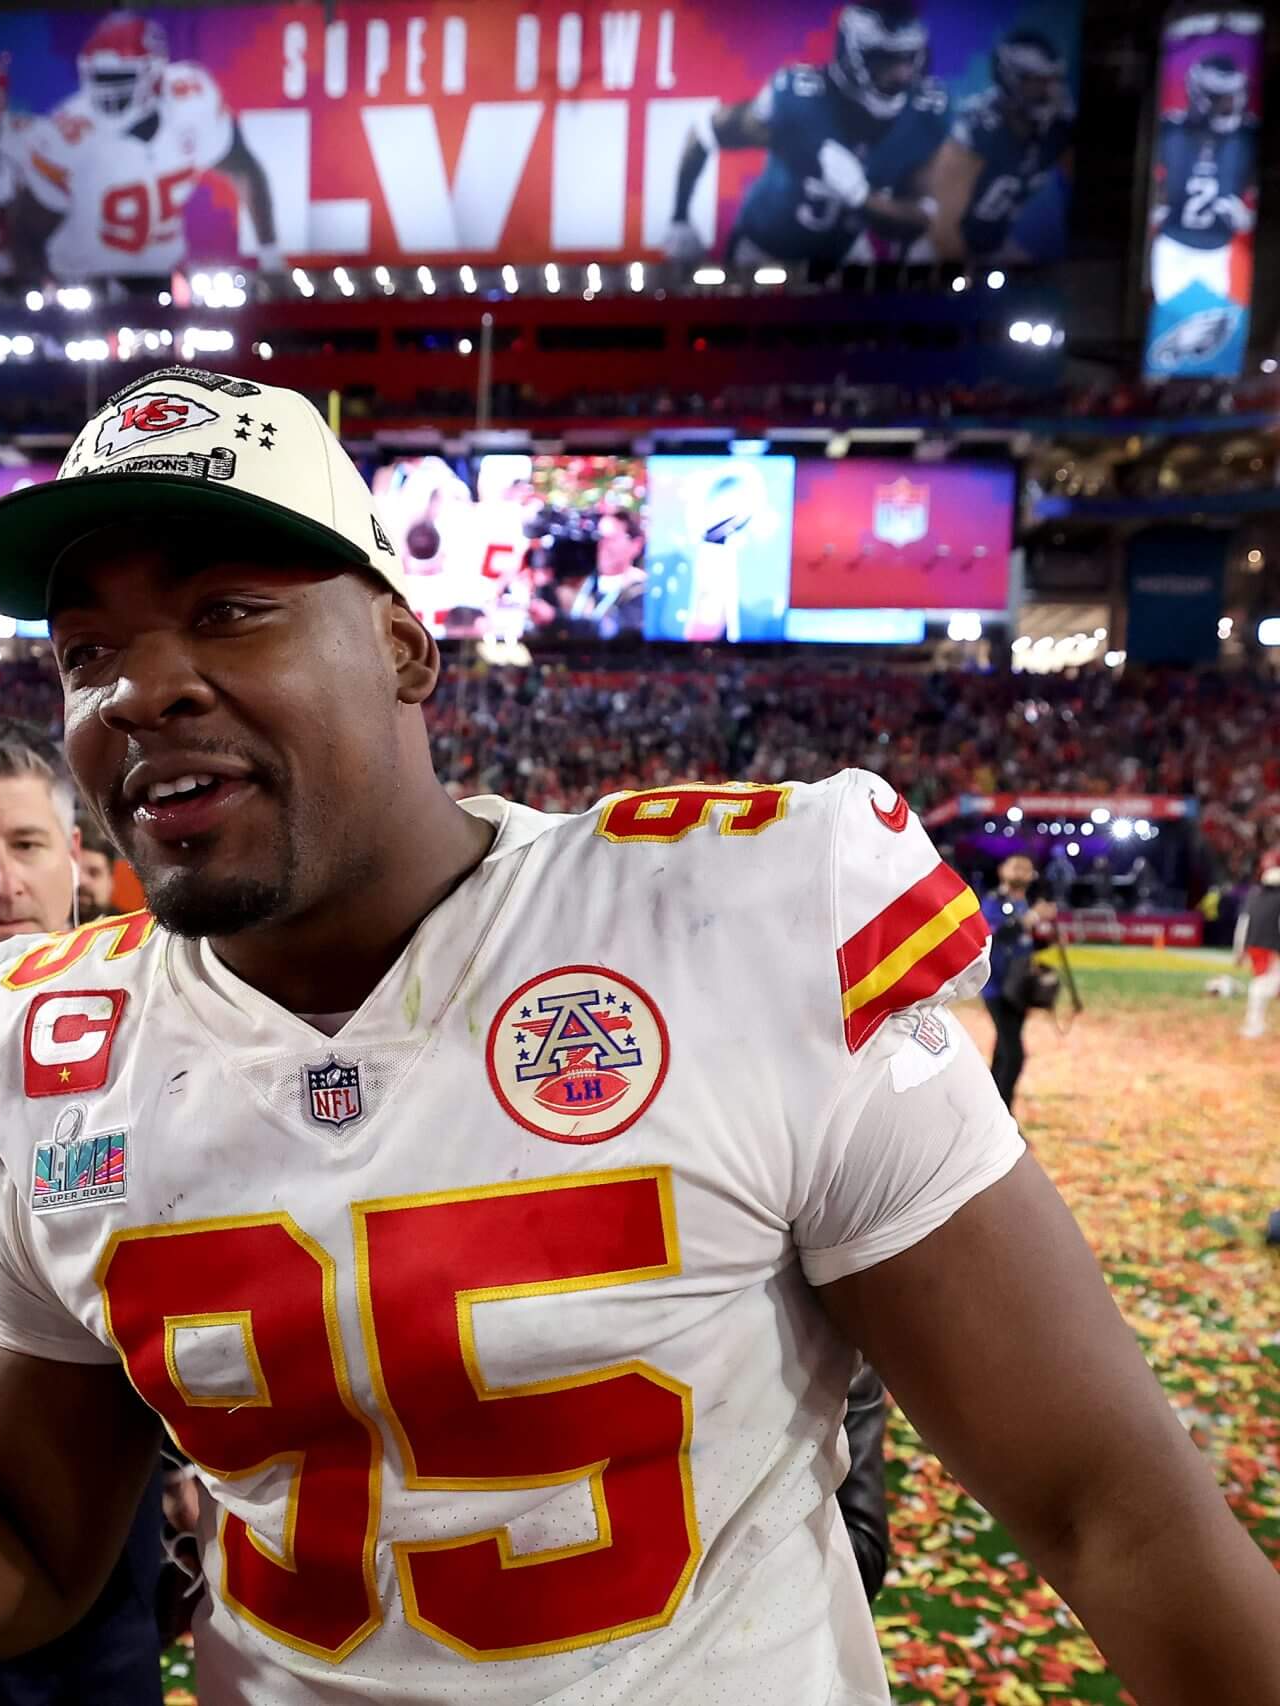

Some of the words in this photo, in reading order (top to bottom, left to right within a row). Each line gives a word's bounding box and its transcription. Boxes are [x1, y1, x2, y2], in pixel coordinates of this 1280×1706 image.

[238, 96, 719, 257] LVII
[104, 459, 189, 473] AMPIONS
[30, 995, 114, 1066] C
[314, 1088, 358, 1120] NFL
[564, 1079, 604, 1103] LH
[42, 1191, 78, 1205] SUPER
[82, 1184, 115, 1198] BOWL
[94, 1164, 704, 1665] 95
